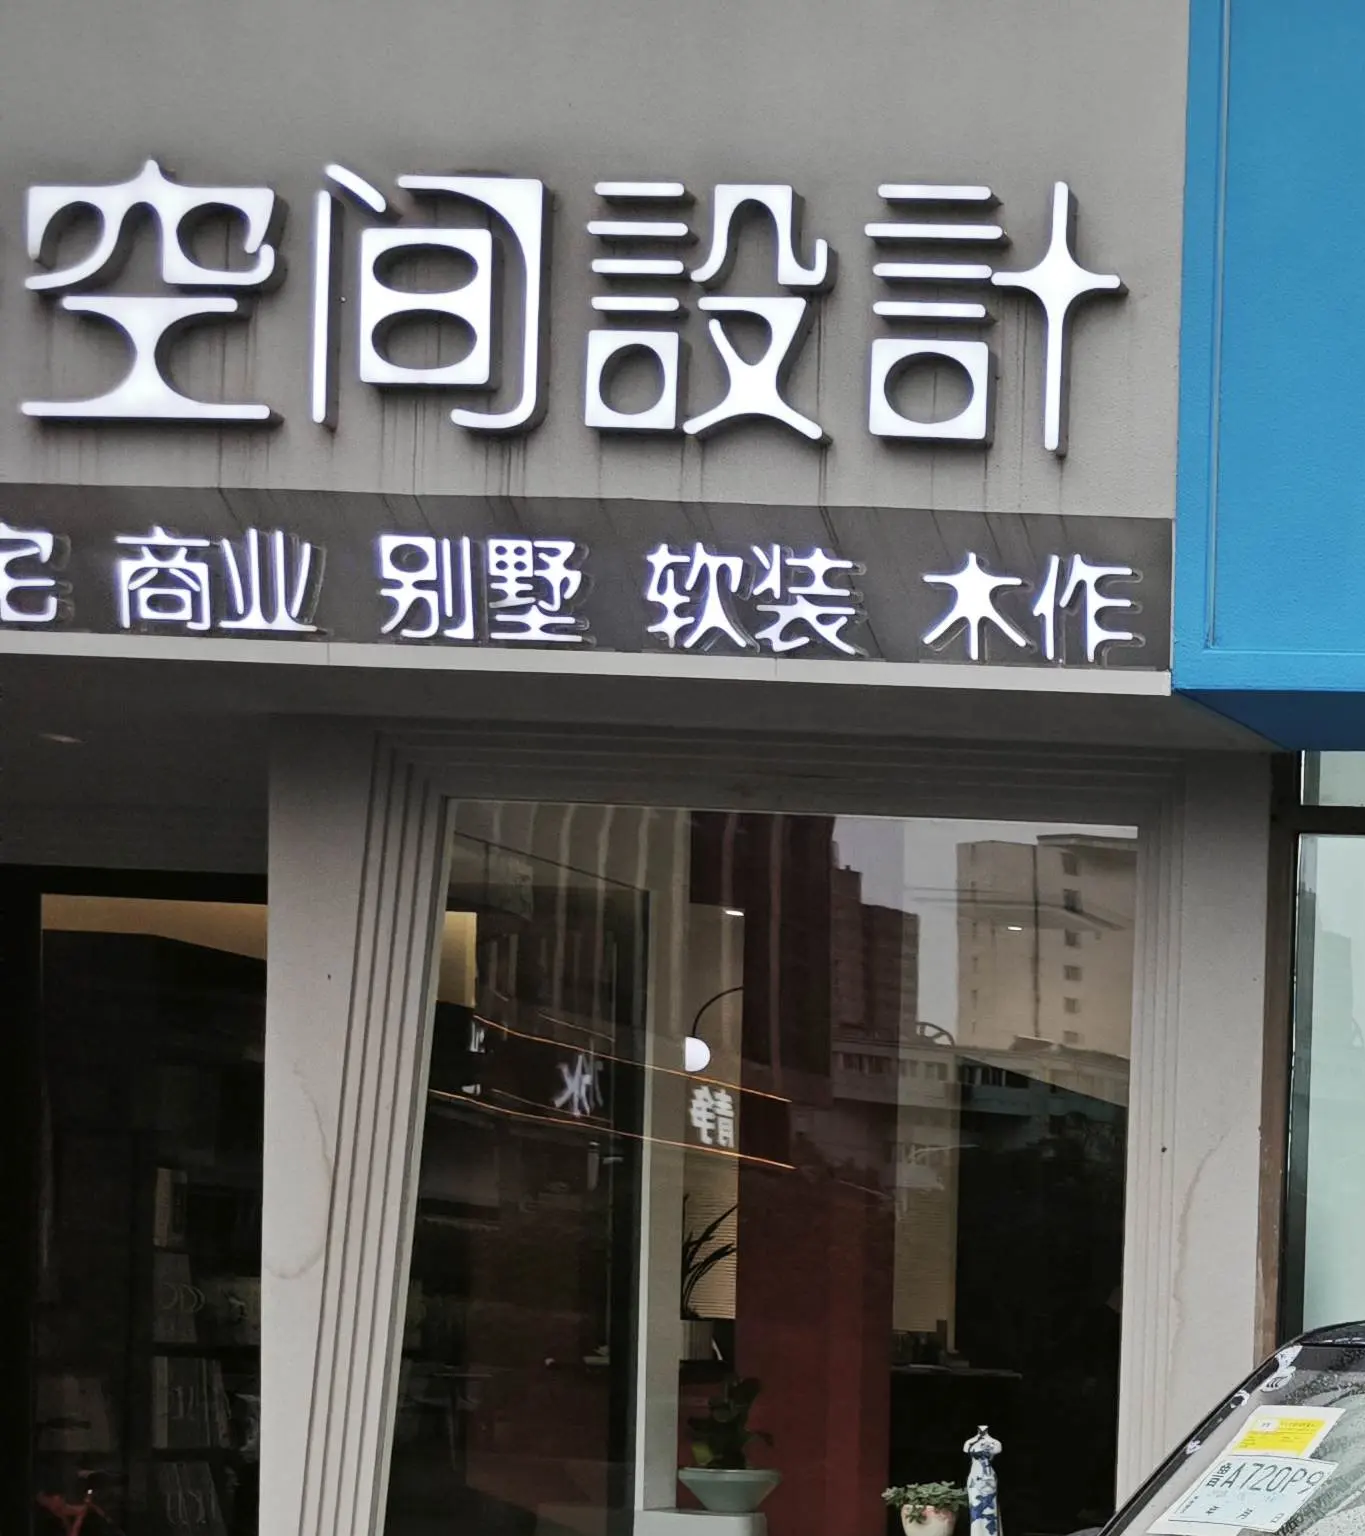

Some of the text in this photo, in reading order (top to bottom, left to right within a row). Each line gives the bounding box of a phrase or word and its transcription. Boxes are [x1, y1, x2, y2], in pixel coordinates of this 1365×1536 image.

[116, 527, 318, 632] 商业
[378, 534, 583, 642] 别墅
[646, 543, 858, 655] 软装
[923, 554, 1134, 662] 木作
